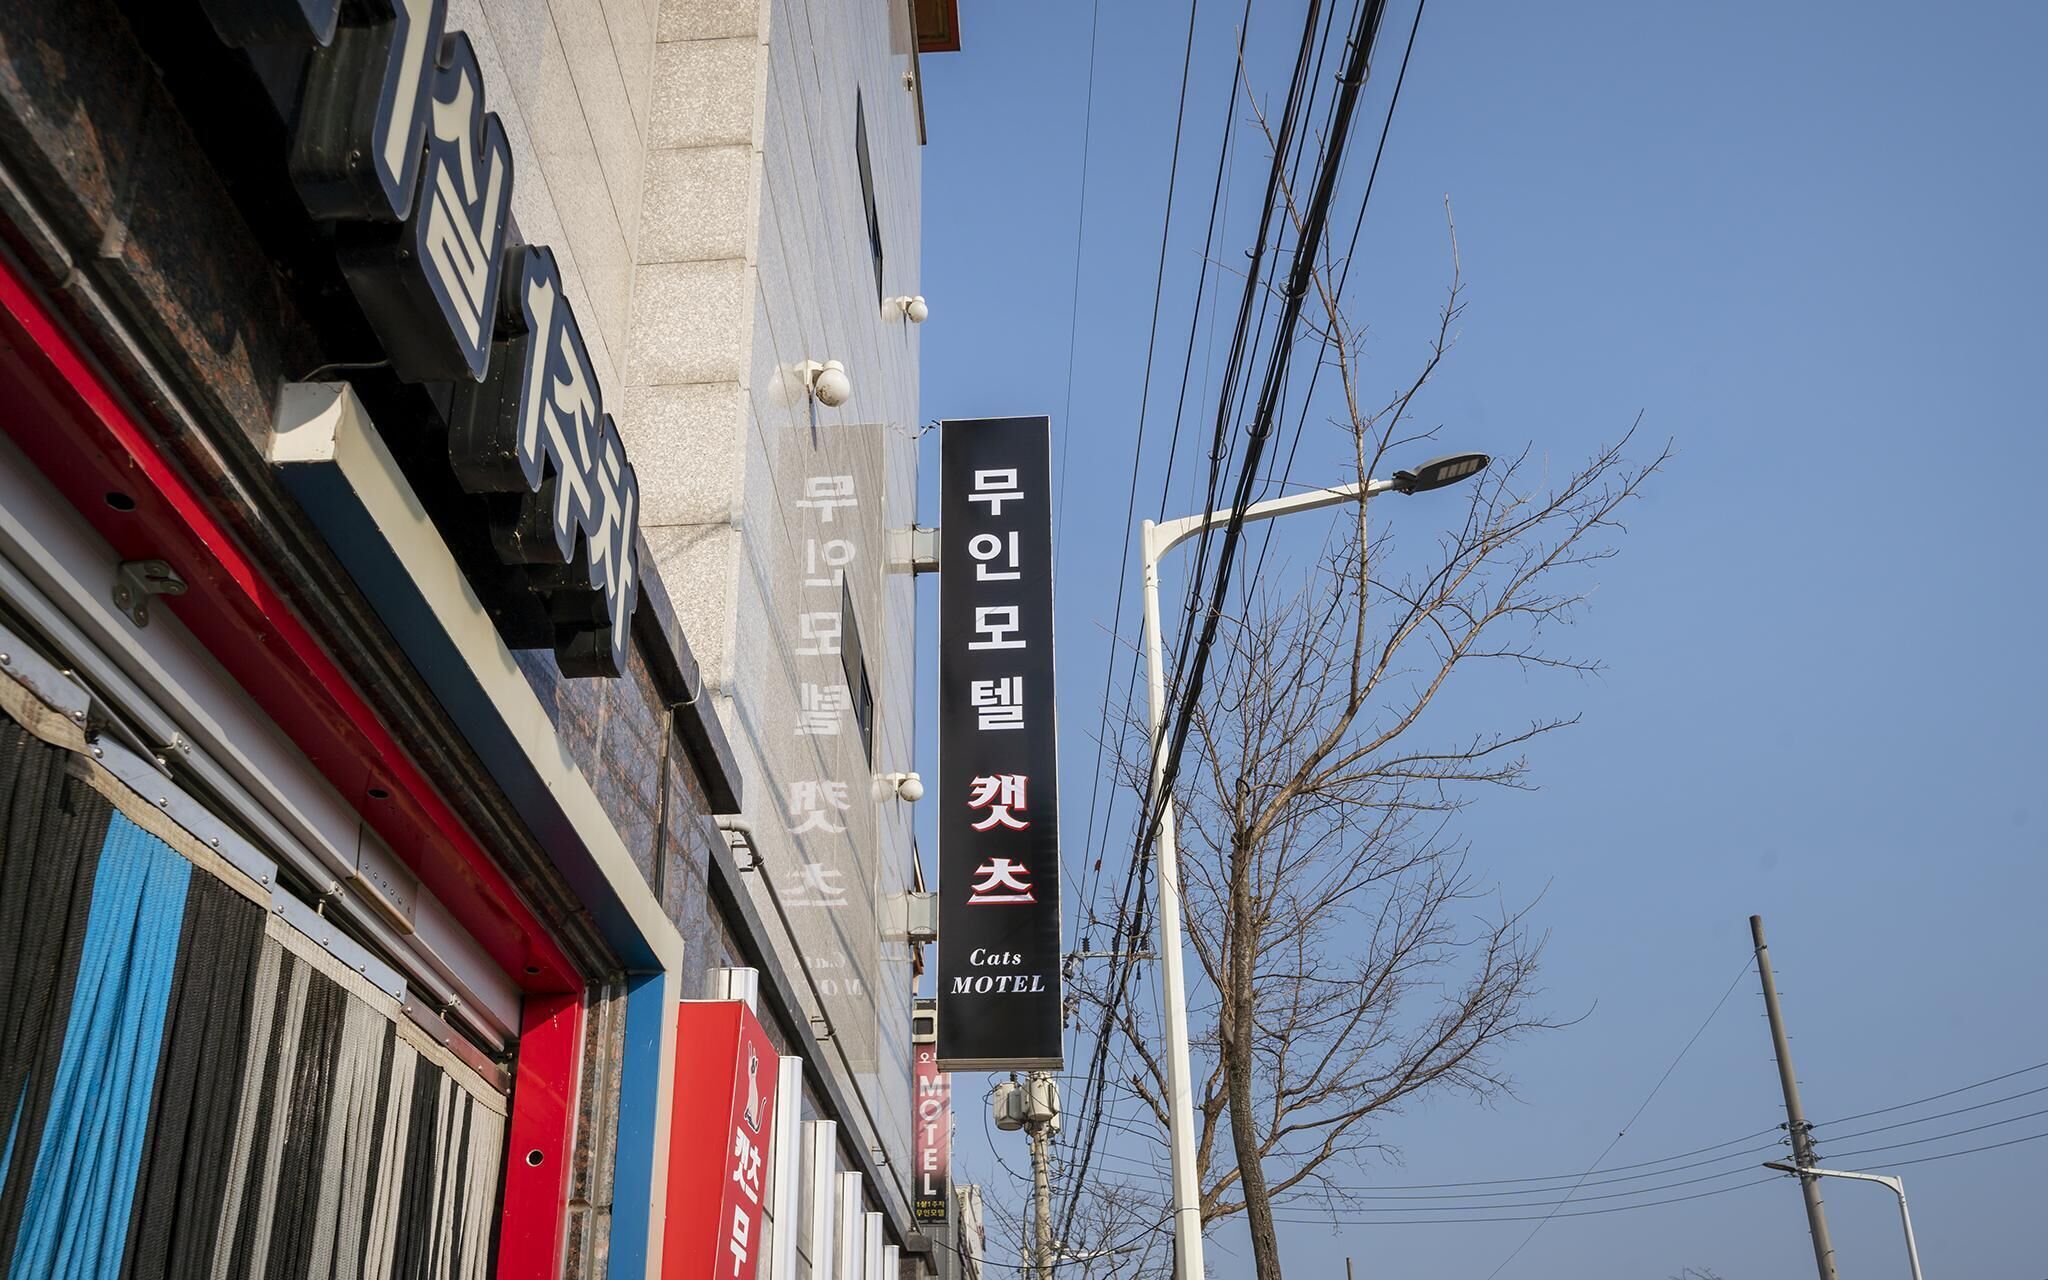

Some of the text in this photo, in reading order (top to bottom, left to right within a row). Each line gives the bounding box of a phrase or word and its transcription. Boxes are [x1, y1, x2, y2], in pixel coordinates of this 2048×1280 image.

[966, 467, 1039, 906] 무인모텔 캣츠
[950, 975, 1046, 995] MOTEL
[969, 948, 1022, 967] Cats
[733, 1126, 762, 1206] 캣츠
[919, 1075, 943, 1196] MOTEL
